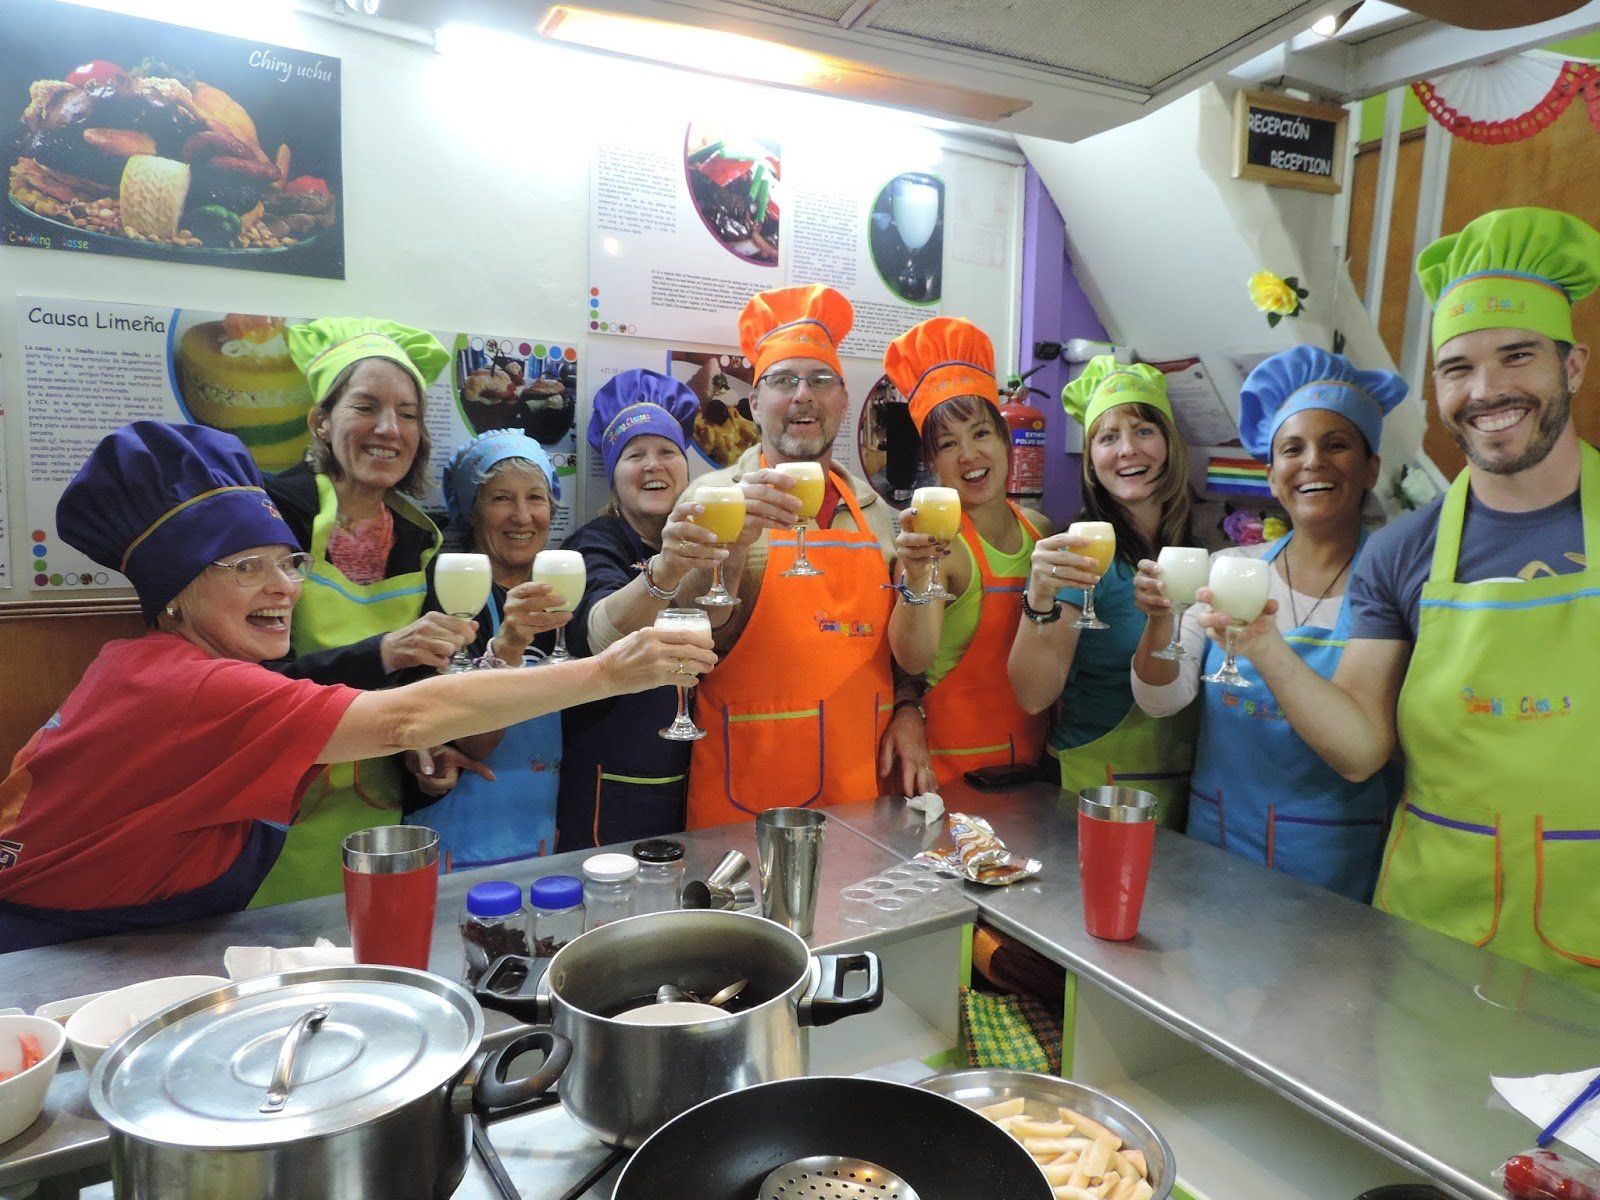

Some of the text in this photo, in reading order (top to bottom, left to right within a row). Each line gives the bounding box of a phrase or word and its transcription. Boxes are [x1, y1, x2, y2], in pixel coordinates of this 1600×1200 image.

[249, 50, 332, 82] Chiry uchu
[1248, 113, 1310, 140] RECEPCIÓN
[1270, 150, 1331, 175] RECEPTION
[28, 307, 166, 333] Causa Limeña
